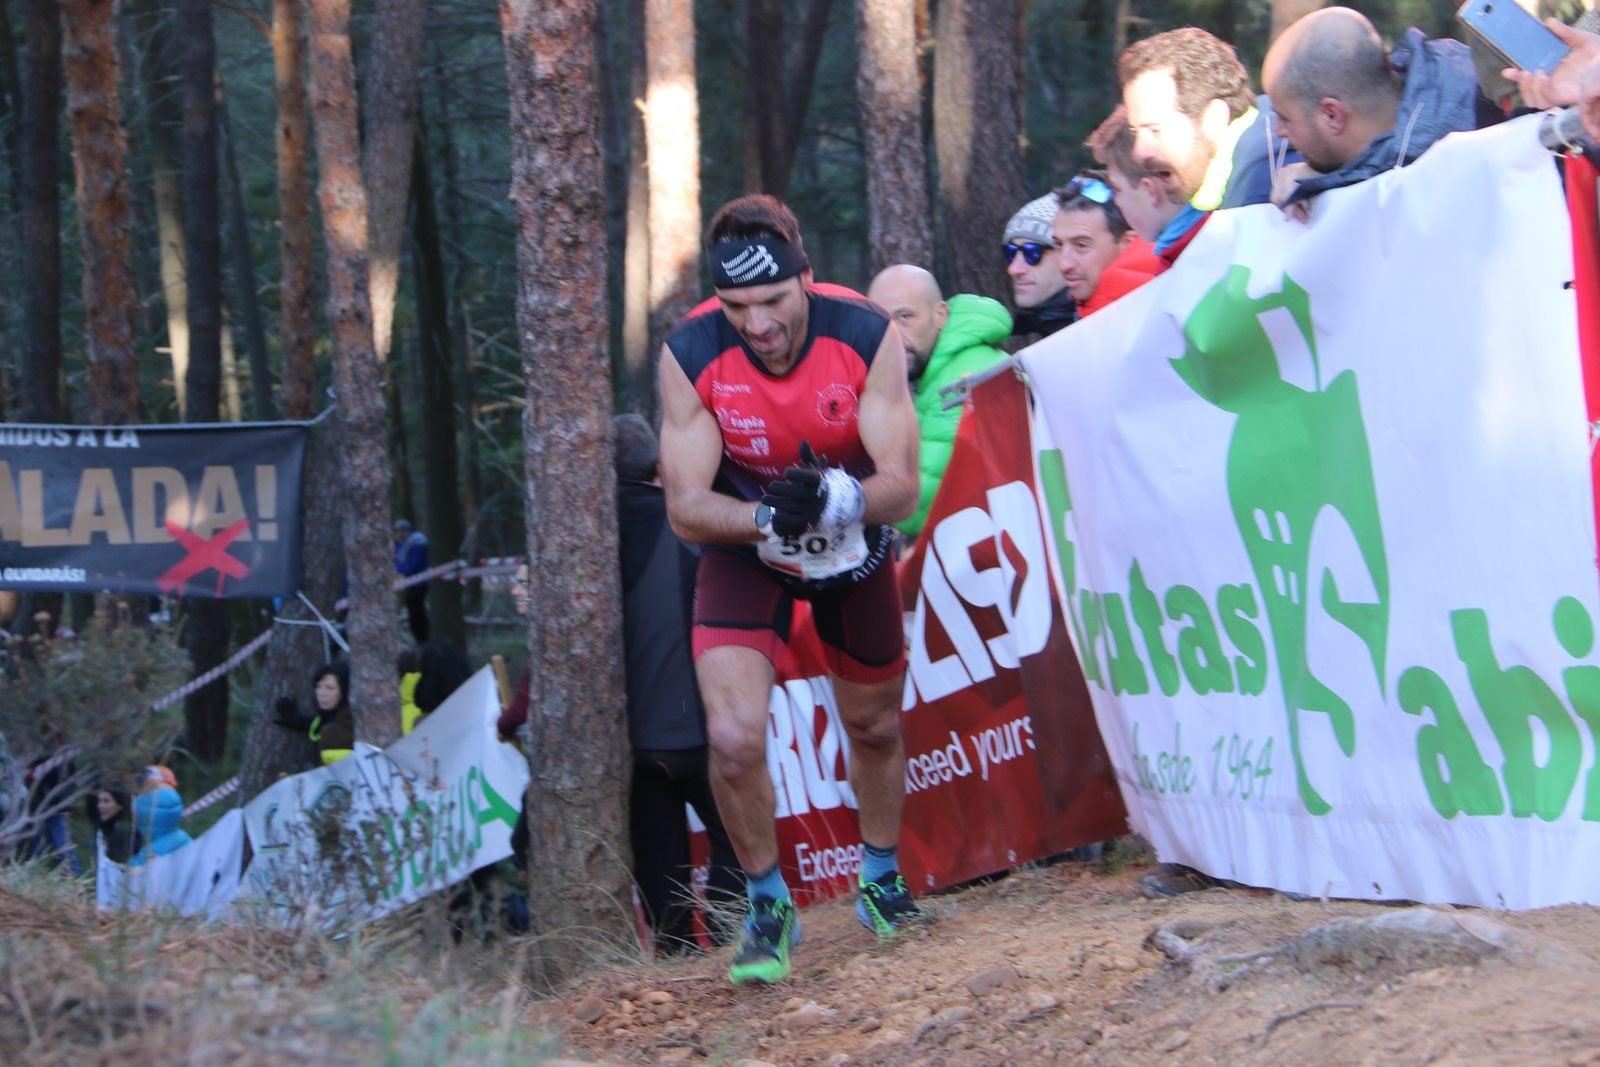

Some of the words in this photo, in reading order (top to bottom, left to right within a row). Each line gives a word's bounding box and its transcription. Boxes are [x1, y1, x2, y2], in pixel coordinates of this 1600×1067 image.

[0, 430, 71, 448] IDOS
[76, 430, 98, 447] A
[104, 430, 139, 448] LA
[1211, 733, 1274, 800] 1964
[795, 842, 866, 882] Excee
